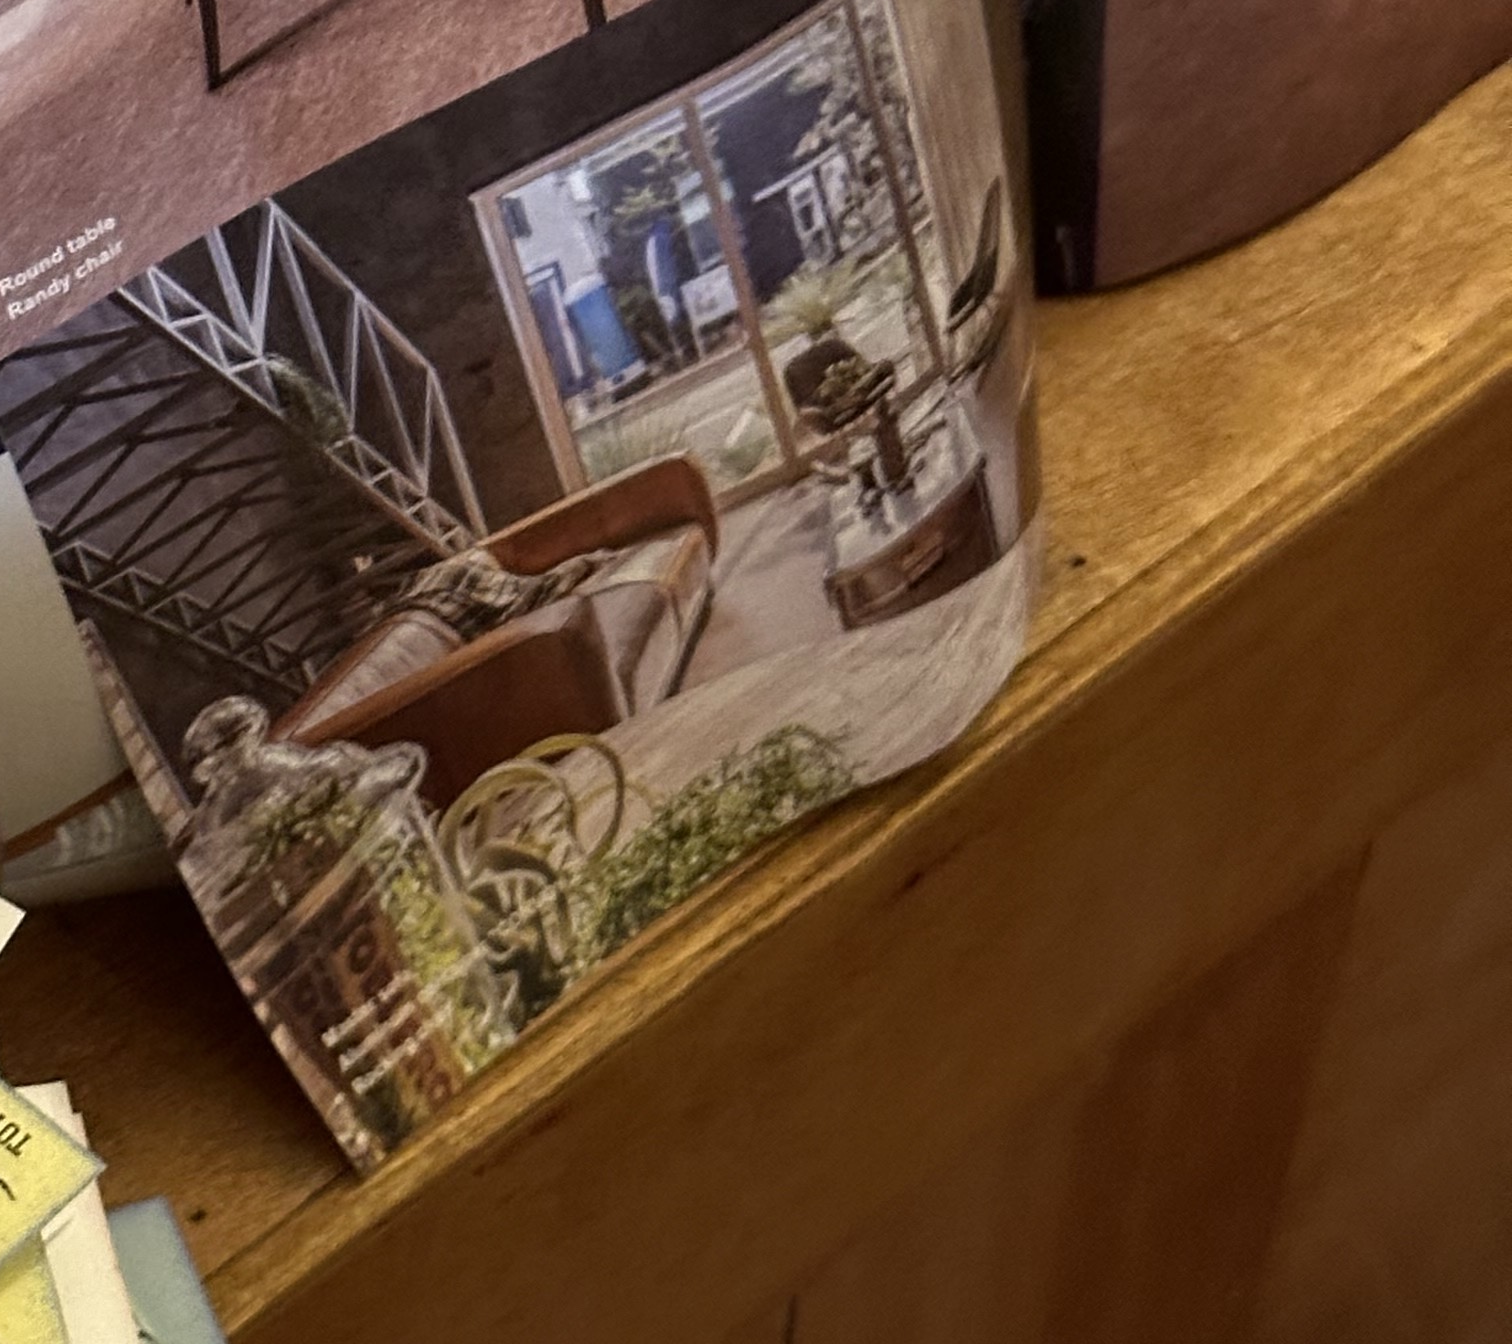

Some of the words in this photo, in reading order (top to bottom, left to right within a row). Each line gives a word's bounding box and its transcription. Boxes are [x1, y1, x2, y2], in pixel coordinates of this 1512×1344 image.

[66, 216, 117, 255] table
[7, 274, 72, 321] Randy
[75, 239, 126, 280] chair
